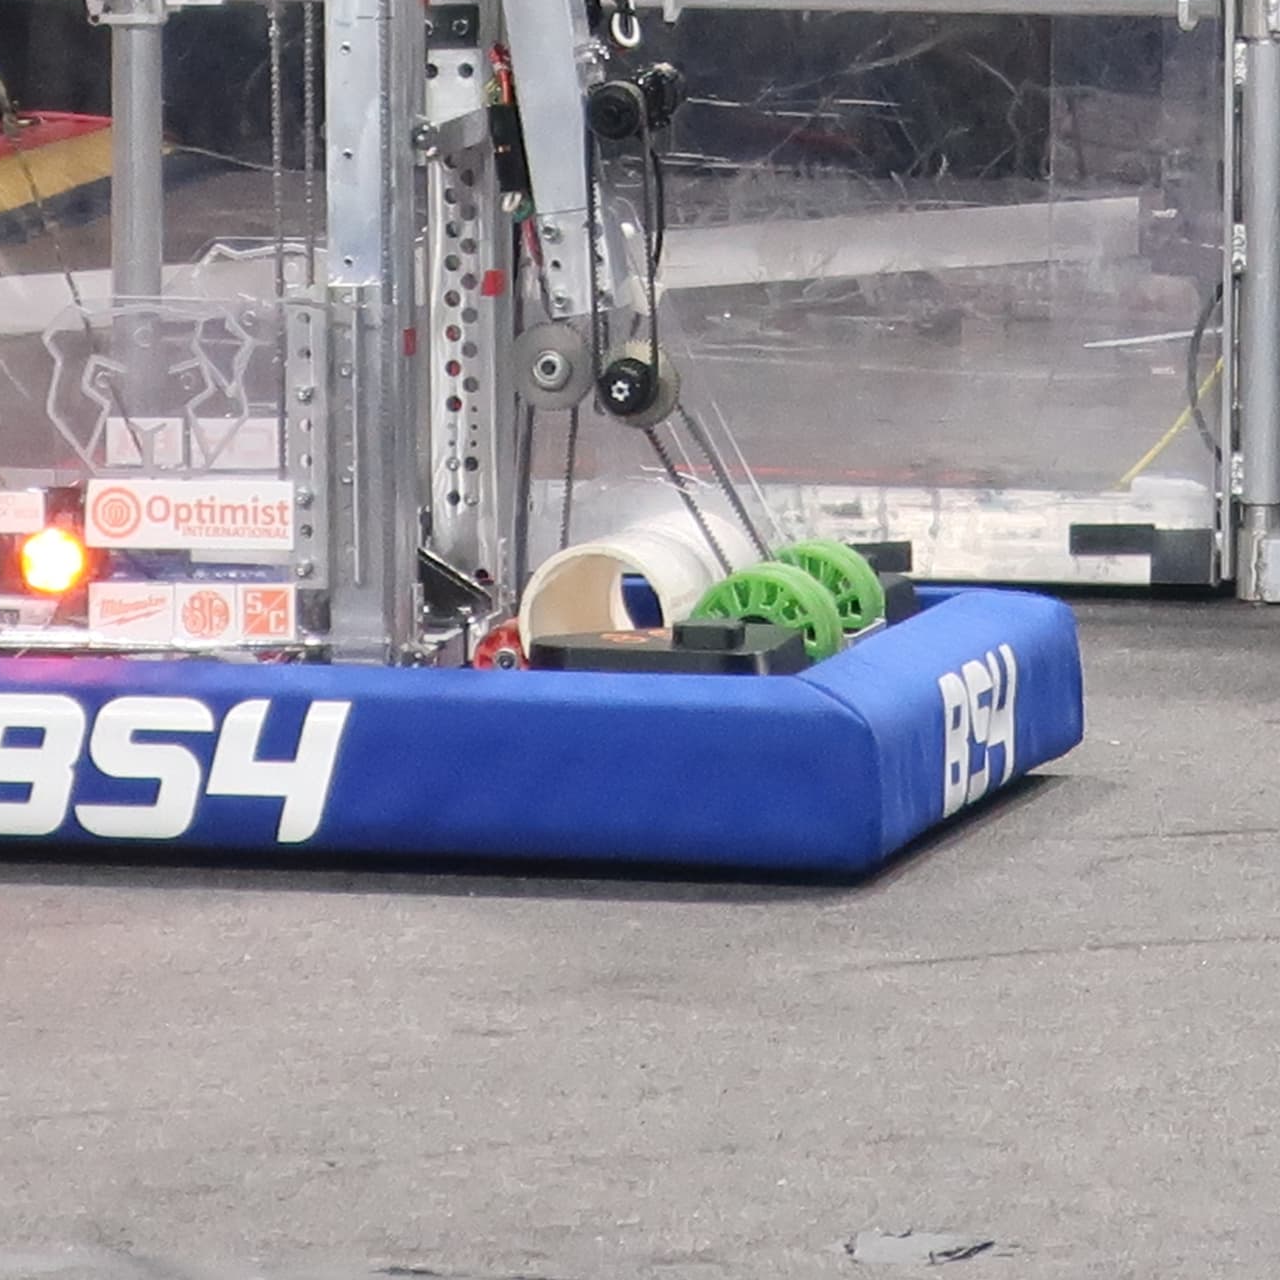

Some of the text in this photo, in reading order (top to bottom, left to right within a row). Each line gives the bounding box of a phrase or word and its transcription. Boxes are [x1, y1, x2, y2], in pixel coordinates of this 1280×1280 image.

[146, 496, 289, 530] Optimist
[182, 527, 289, 539] INTERNATIONAL
[938, 643, 1017, 818] 854
